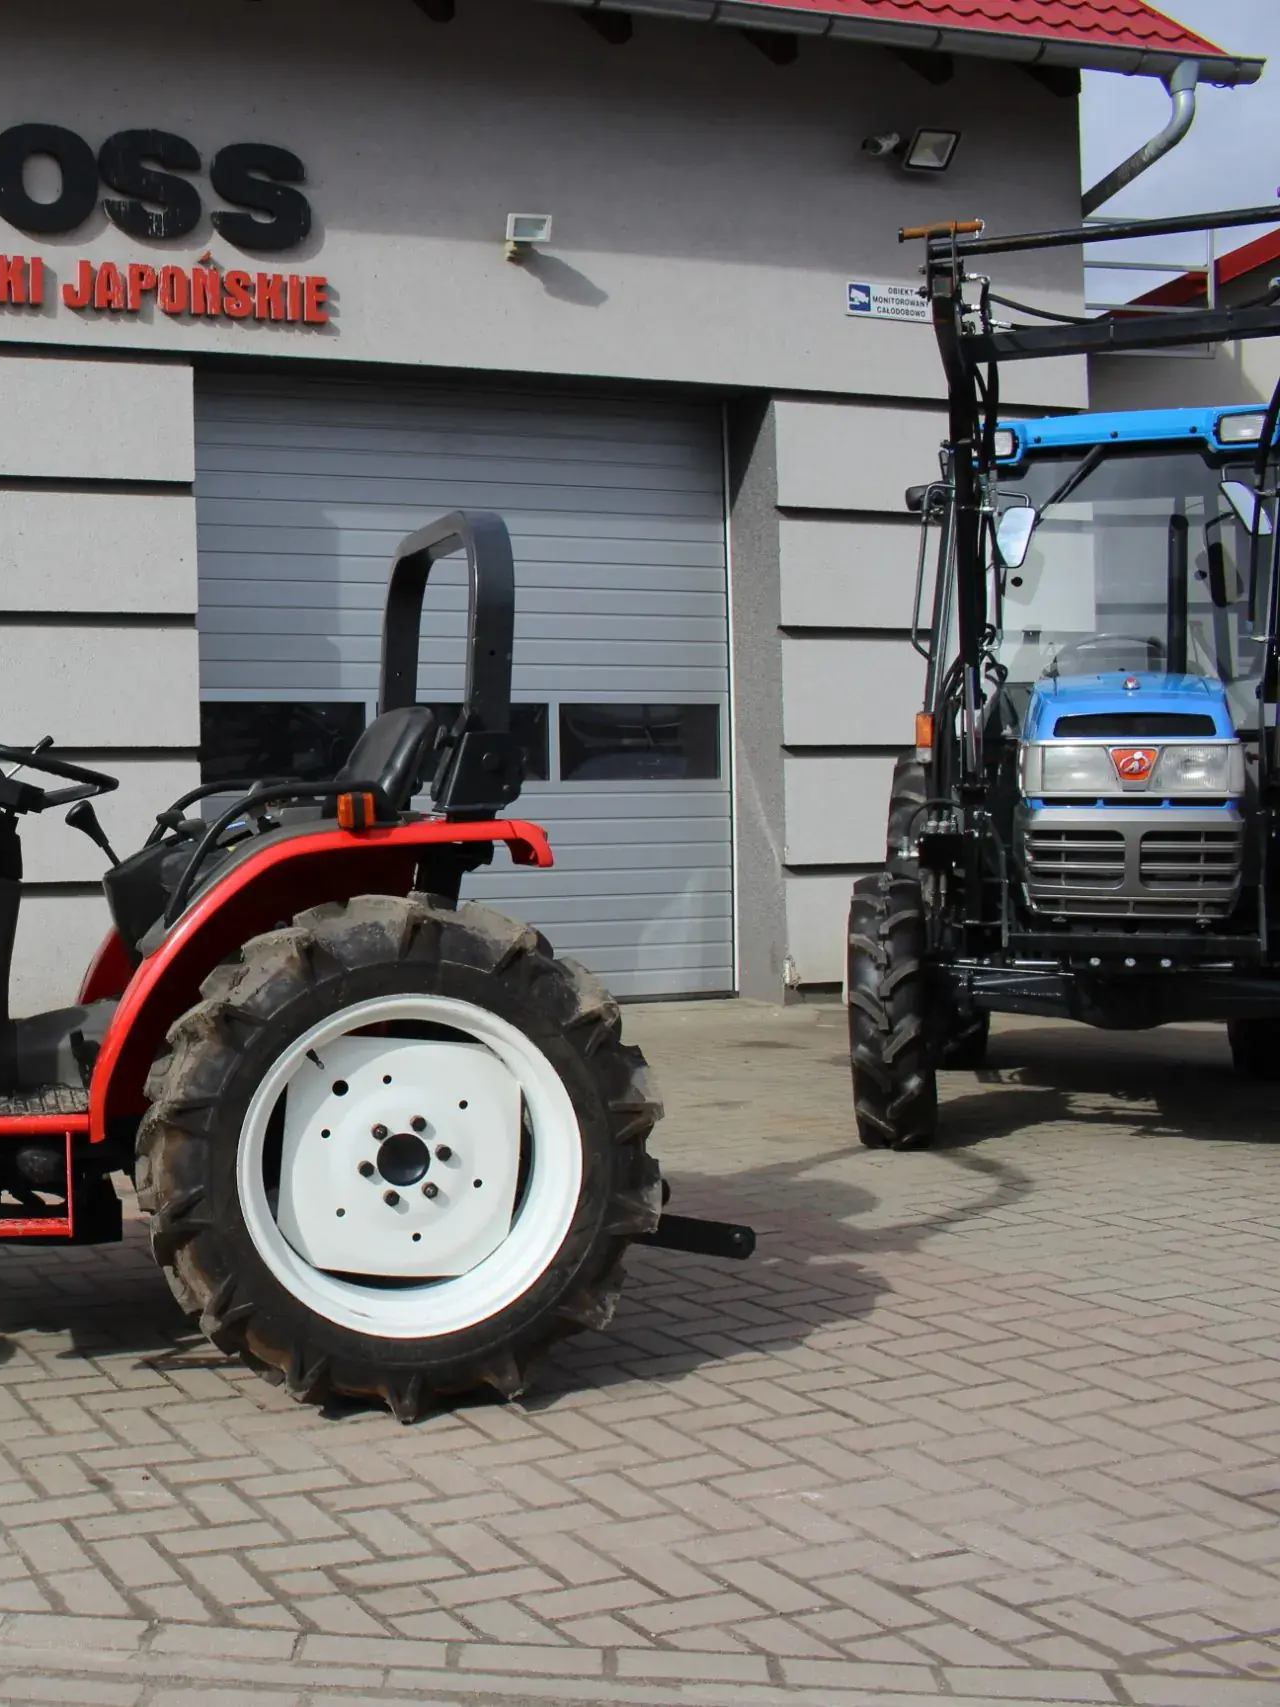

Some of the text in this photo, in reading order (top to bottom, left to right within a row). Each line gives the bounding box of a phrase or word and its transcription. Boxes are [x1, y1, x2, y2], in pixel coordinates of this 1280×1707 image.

[62, 251, 329, 323] JAPOŃSKIE
[888, 287, 914, 296] OBIEKT
[872, 296, 929, 307] MONITOROWANY
[876, 306, 926, 318] CAŁODOBOWO
